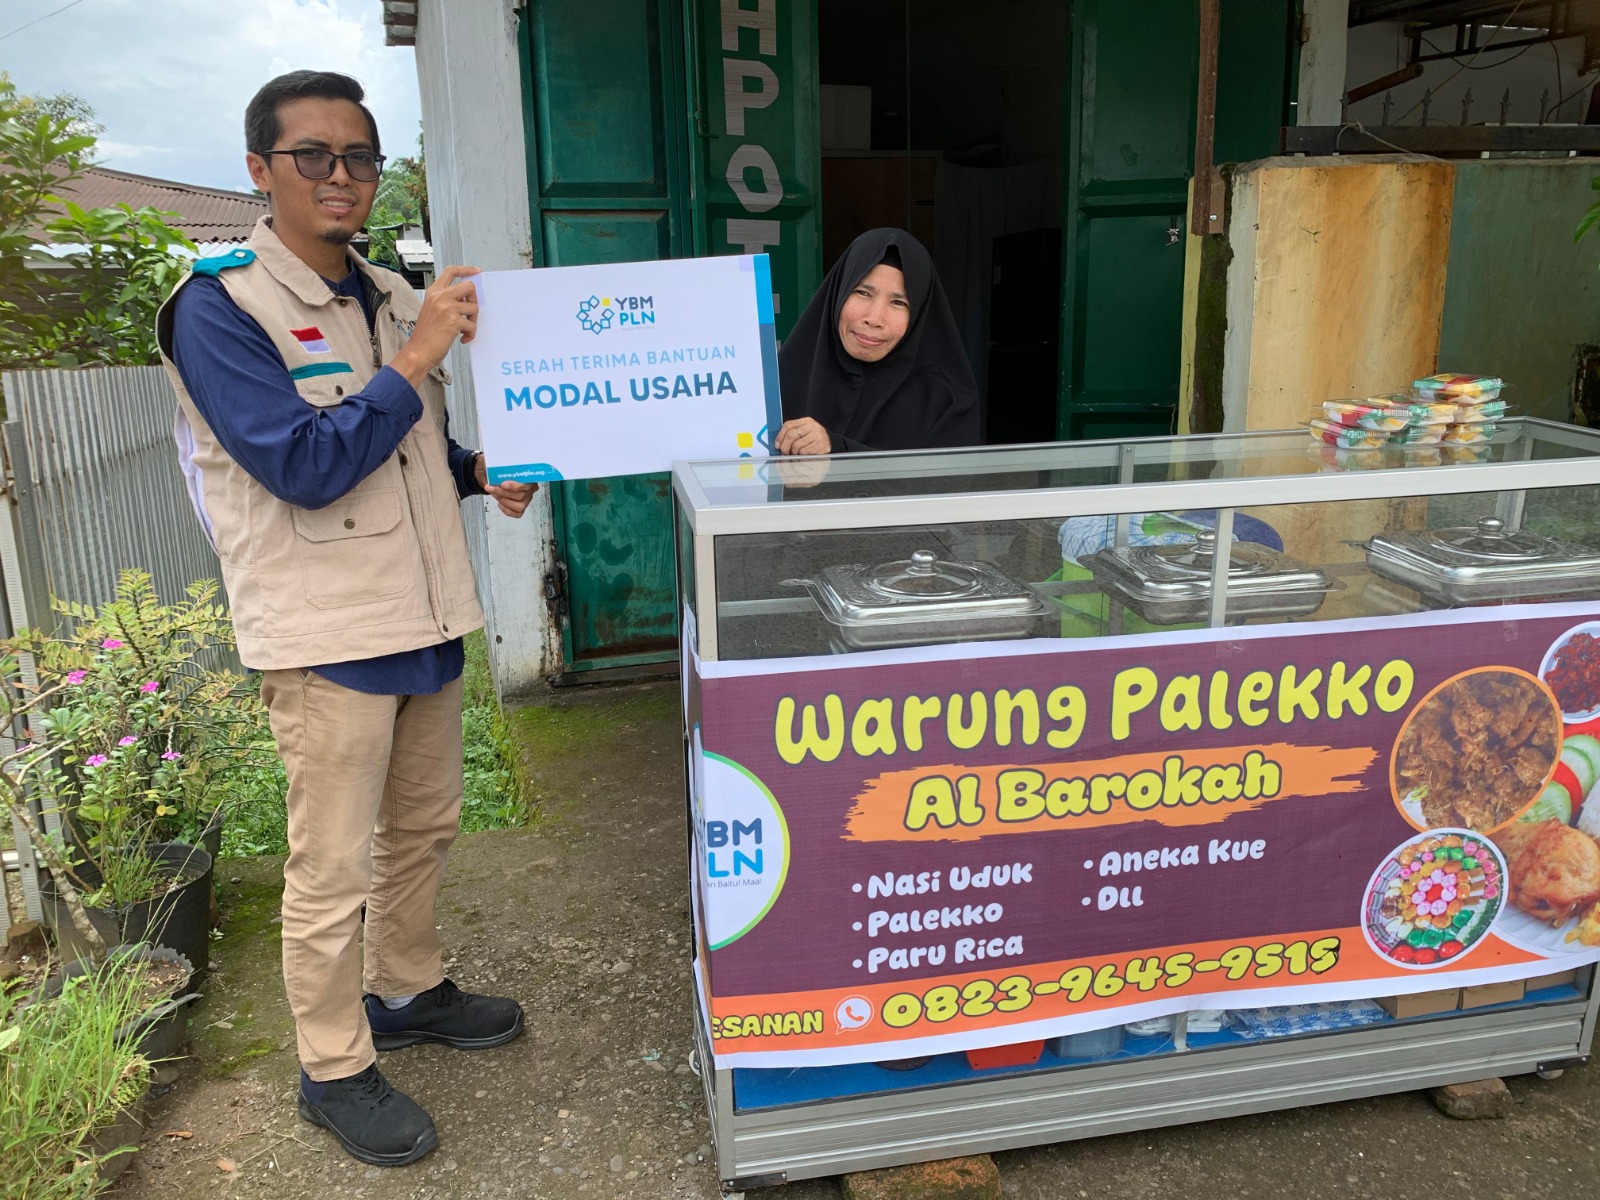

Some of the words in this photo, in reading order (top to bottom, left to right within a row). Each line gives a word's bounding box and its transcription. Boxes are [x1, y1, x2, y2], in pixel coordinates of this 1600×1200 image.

[614, 295, 654, 311] YBM
[619, 310, 656, 326] PLN
[501, 357, 564, 376] SERAH
[570, 350, 641, 371] TERIMA
[647, 344, 736, 367] BANTUAN
[504, 379, 622, 412] MODAL
[629, 370, 738, 402] USAHA
[774, 684, 1089, 766] Warung
[1110, 658, 1415, 742] Palekko
[904, 775, 986, 831] Al
[996, 750, 1282, 823] Barokah
[698, 817, 762, 848] BM
[702, 848, 764, 878] LN
[1099, 844, 1200, 877] Aneka
[1208, 839, 1267, 865] Kue
[717, 879, 741, 888] Baitul
[742, 877, 762, 887] Maal
[867, 871, 941, 899] Nasi
[949, 862, 1033, 891] Uduk
[1097, 885, 1144, 911] Dll
[867, 902, 1003, 938] Palekko
[867, 944, 946, 974] Paru
[954, 935, 1024, 964] Rica
[711, 1009, 824, 1040] ESANAN
[881, 938, 1342, 1028] 0823-9645-9515
